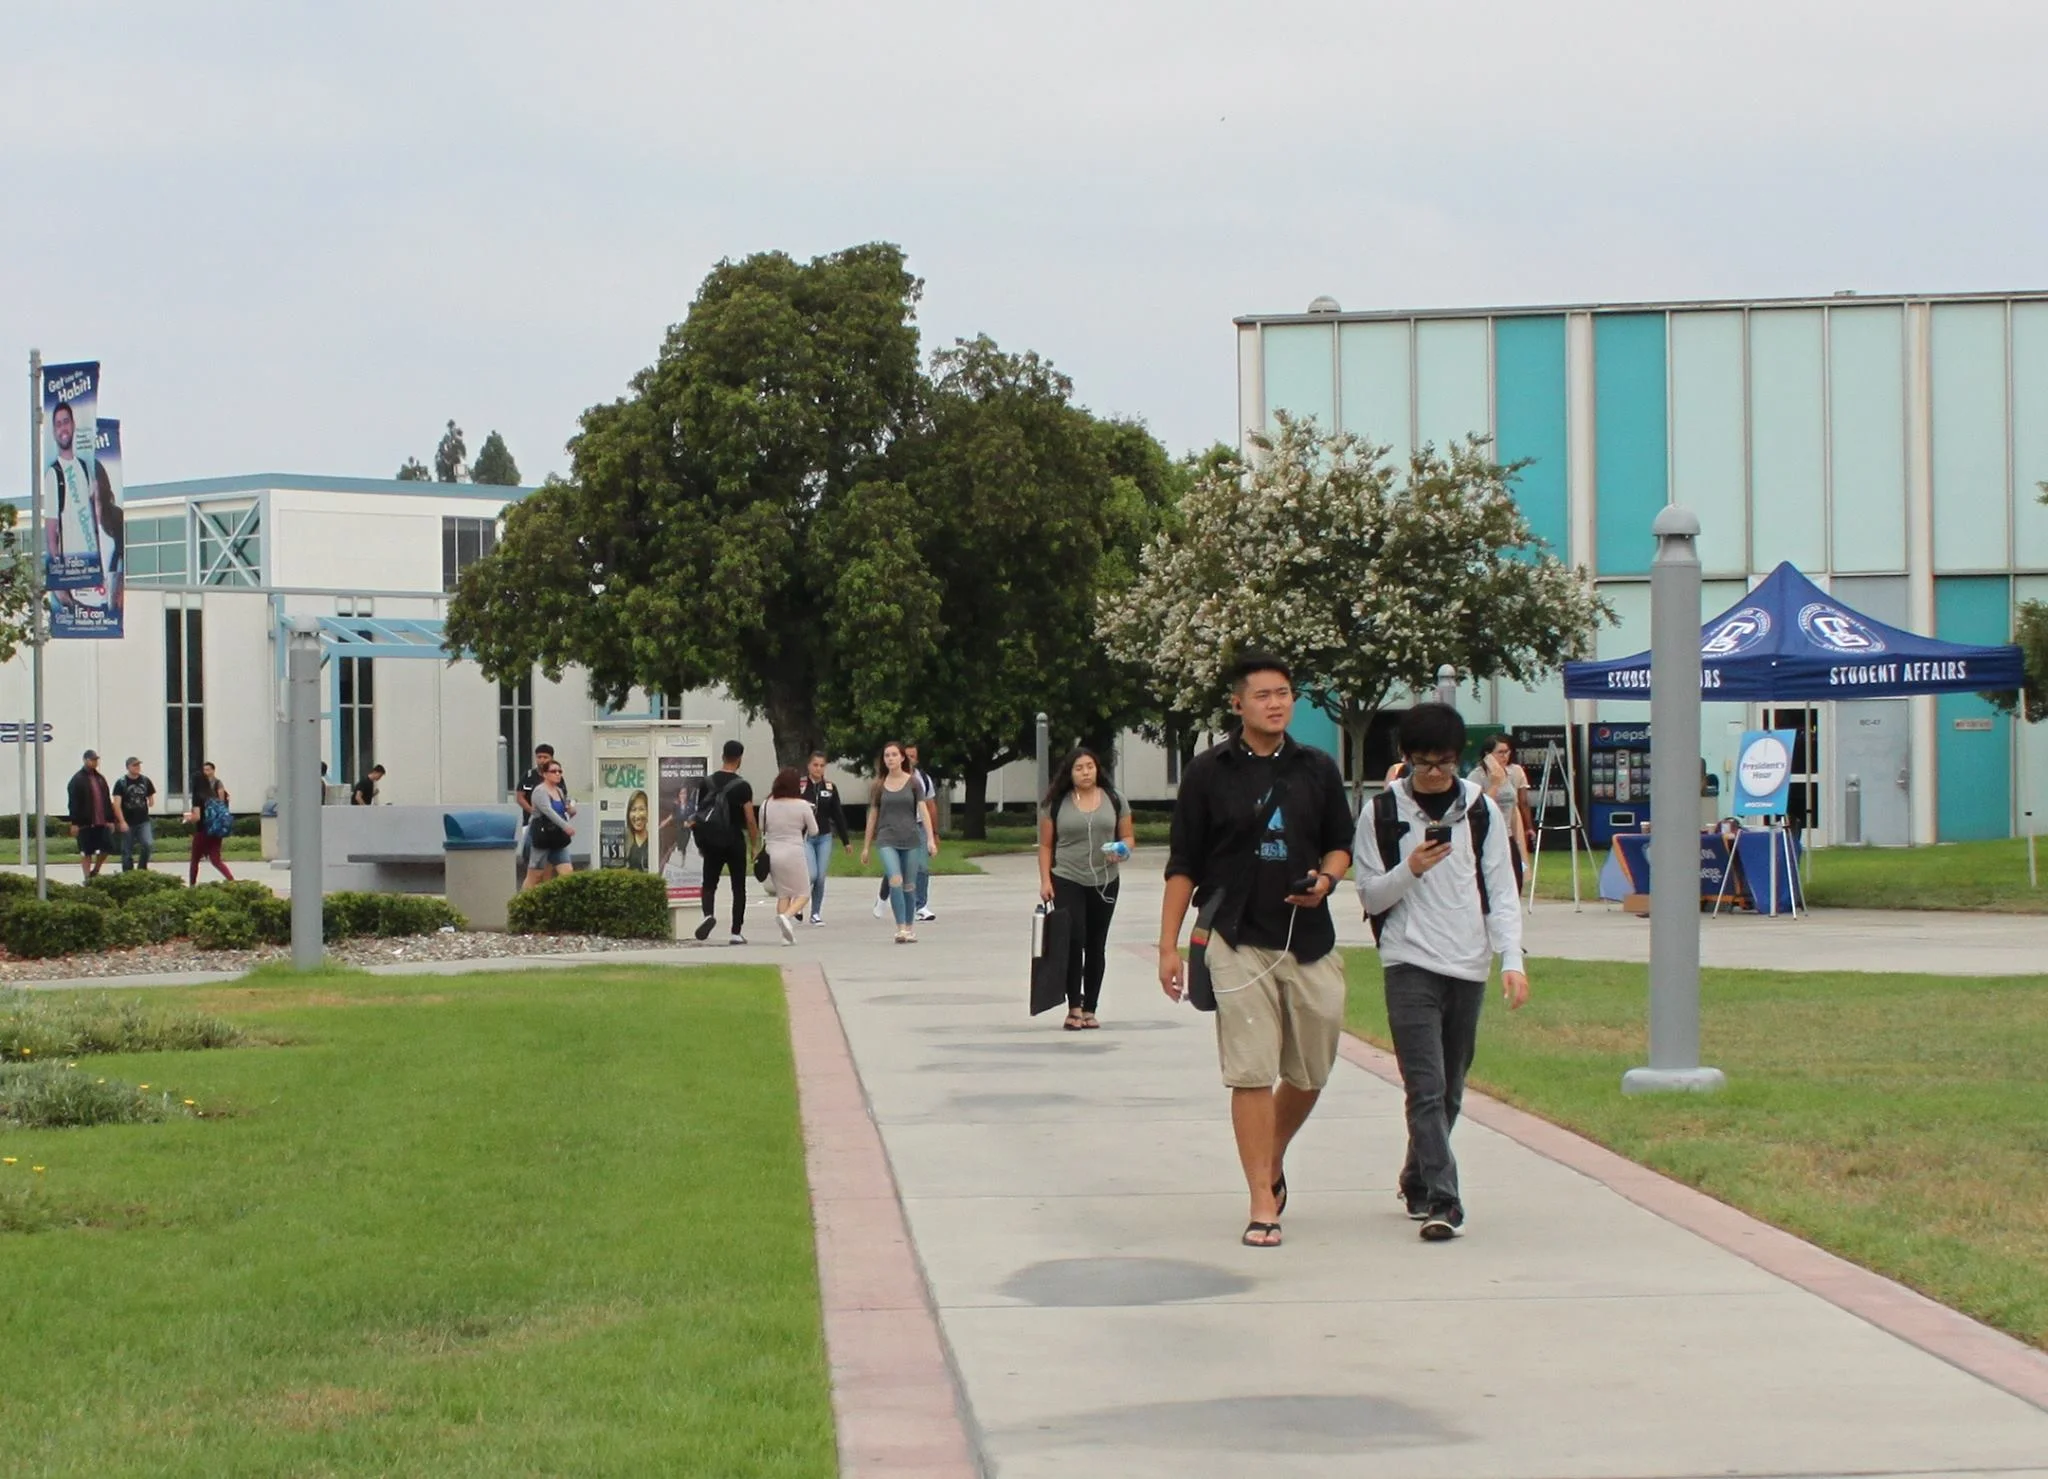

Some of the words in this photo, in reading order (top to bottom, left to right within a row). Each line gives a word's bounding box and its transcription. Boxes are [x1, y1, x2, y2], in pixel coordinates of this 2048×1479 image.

[48, 377, 64, 393] Get
[58, 376, 91, 402] Habit!
[95, 432, 110, 449] it!
[64, 464, 80, 503] New
[1830, 665, 1897, 686] STUDENT
[1903, 661, 1966, 683] AFFAIRS
[661, 770, 679, 778] 100%
[680, 769, 705, 778] ONLINE
[1743, 762, 1785, 770] President's
[605, 767, 645, 788] CARE
